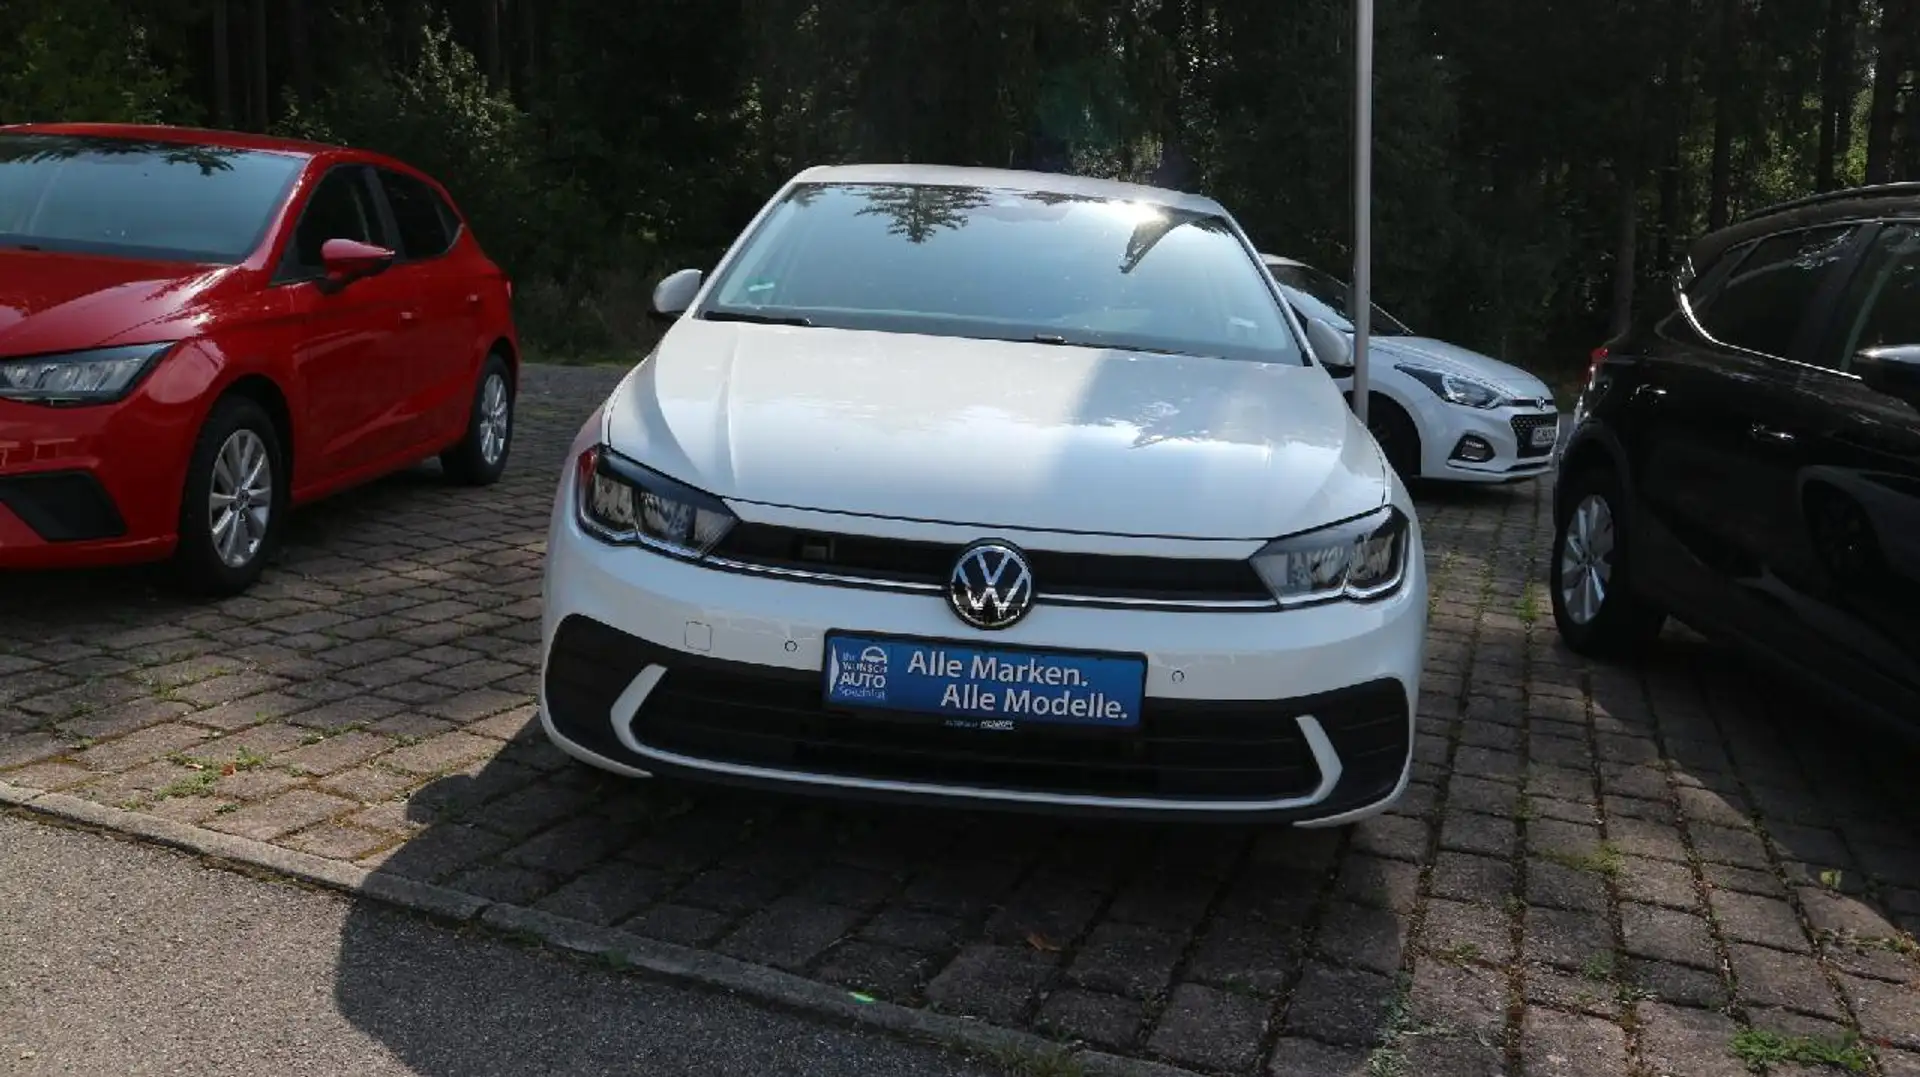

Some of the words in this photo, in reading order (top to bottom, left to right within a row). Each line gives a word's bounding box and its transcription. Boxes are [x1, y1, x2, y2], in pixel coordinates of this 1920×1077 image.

[839, 672, 886, 688] AUTO
[907, 650, 963, 677] Alle
[970, 654, 1088, 687] Marken.
[940, 684, 996, 711] Alle
[1003, 688, 1128, 719] Modelle.
